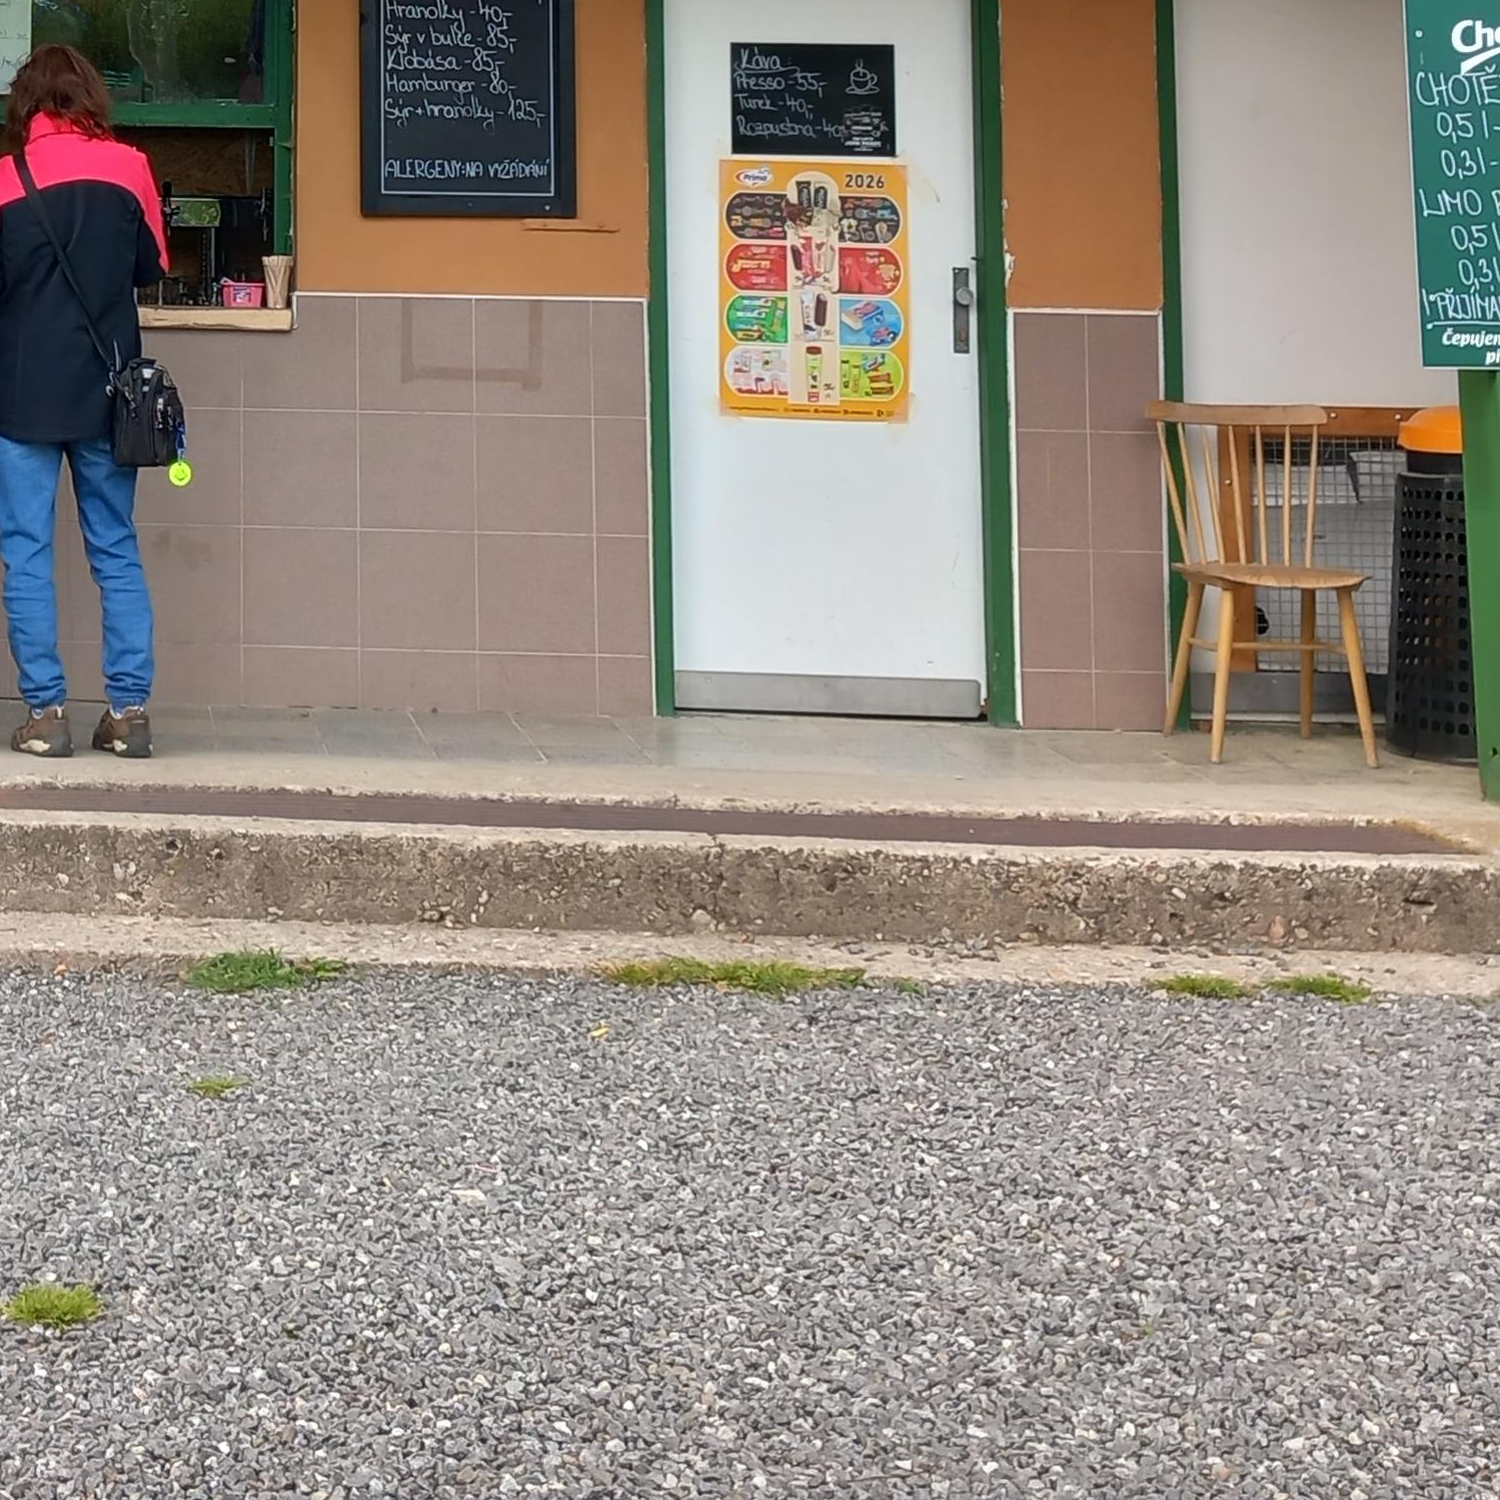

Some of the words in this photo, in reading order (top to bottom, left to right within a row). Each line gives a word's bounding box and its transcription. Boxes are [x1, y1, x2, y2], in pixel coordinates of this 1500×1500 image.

[385, 23, 412, 53] Sýr
[416, 32, 426, 44] v
[387, 48, 462, 70] Klobása
[386, 73, 476, 105] Hamburger
[734, 93, 779, 110] Turek
[844, 173, 885, 189] 2026
[1419, 188, 1482, 217] LIMO
